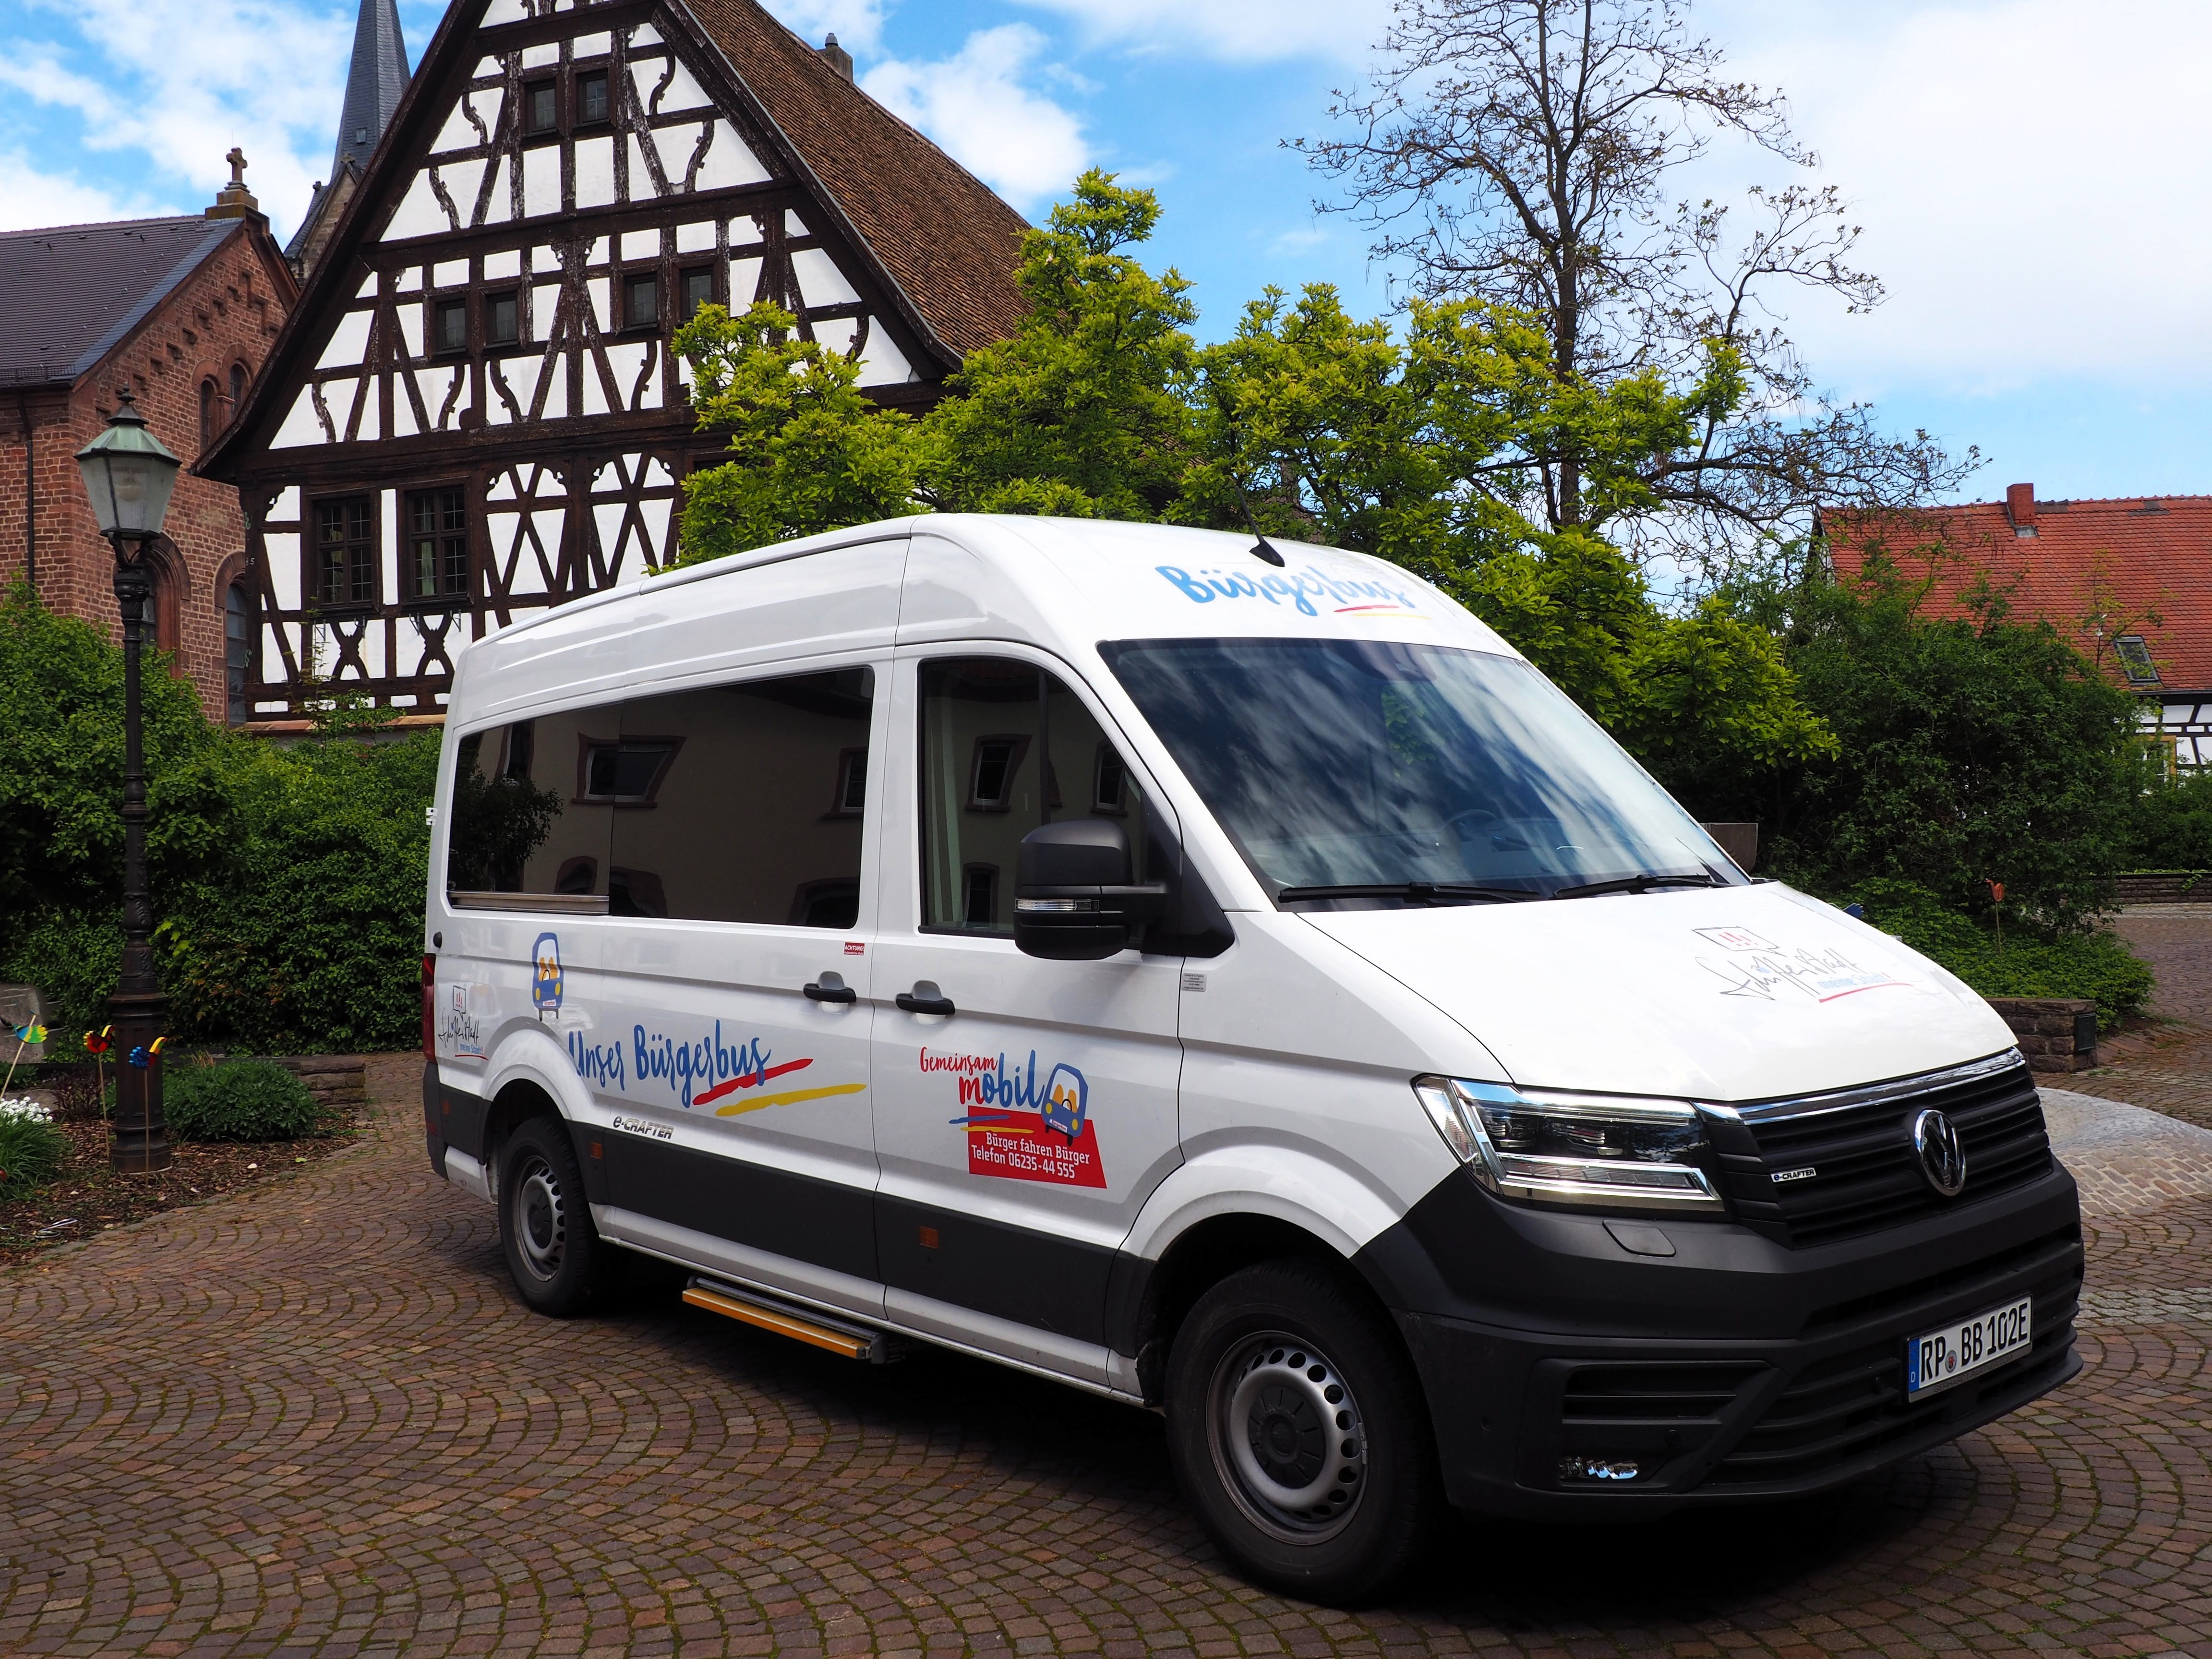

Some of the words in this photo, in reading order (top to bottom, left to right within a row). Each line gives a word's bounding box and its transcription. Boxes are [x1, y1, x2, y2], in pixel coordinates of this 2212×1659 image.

[1154, 565, 1416, 617] Bürgerbus
[1817, 977, 1857, 989] meine
[568, 1030, 625, 1091] Unser
[634, 1019, 771, 1108] Bürgerbus
[920, 1046, 998, 1075] Gemeinsam
[959, 1049, 1045, 1108] mobil
[613, 1116, 674, 1139] e-CRAFTER
[972, 1144, 1006, 1165] Telefon
[1009, 1152, 1055, 1175] 06235-44
[1057, 1161, 1075, 1179] 555
[986, 1132, 1017, 1152] Bürger
[1020, 1138, 1053, 1157] fahren
[1056, 1145, 1090, 1166] Bürger
[1774, 1169, 1815, 1181] e-CRAFTER
[1911, 1371, 1915, 1383] D
[1921, 1336, 1946, 1382] RP
[1961, 1322, 1983, 1367] BB
[1986, 1302, 2028, 1356] 102E
